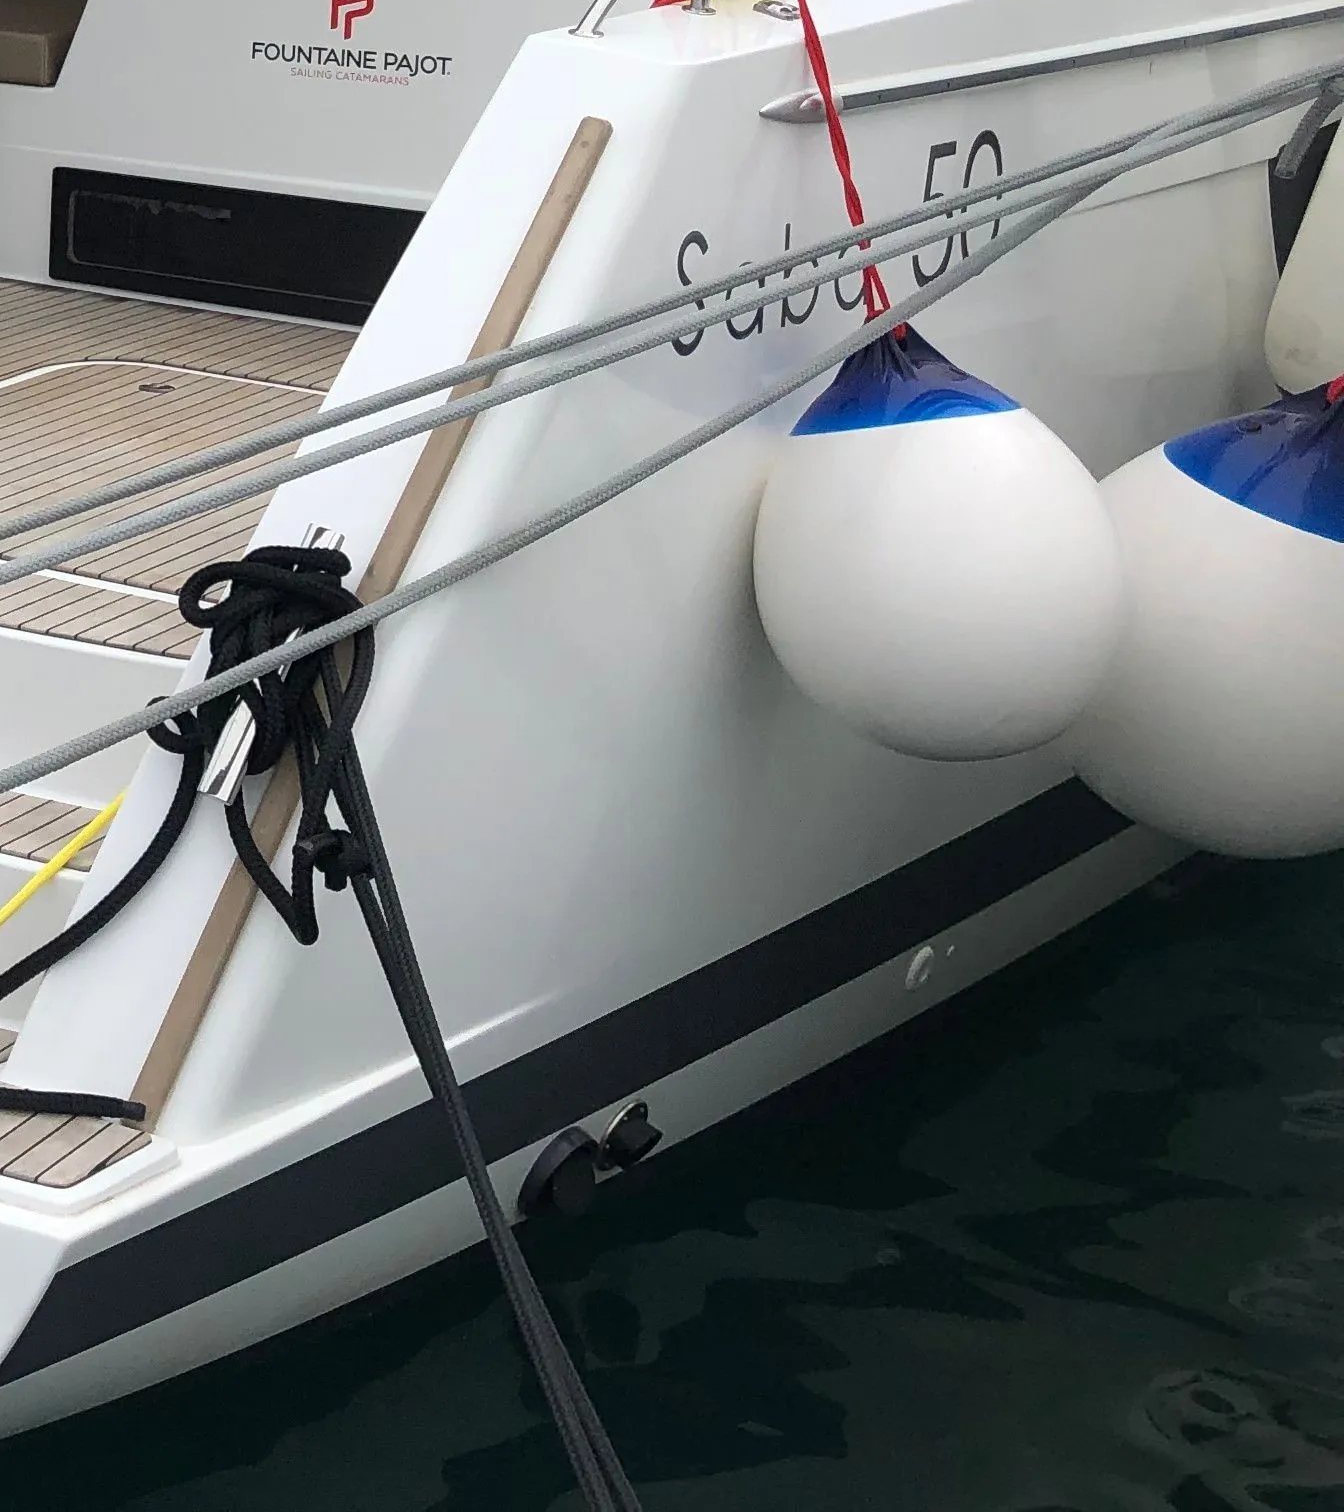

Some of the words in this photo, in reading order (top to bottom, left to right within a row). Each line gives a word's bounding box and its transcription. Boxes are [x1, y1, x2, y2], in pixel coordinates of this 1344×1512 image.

[251, 41, 378, 70] FOUNTAINE
[290, 66, 332, 80] SAILING
[335, 70, 410, 86] CATAMARANS
[910, 128, 1004, 288] 50
